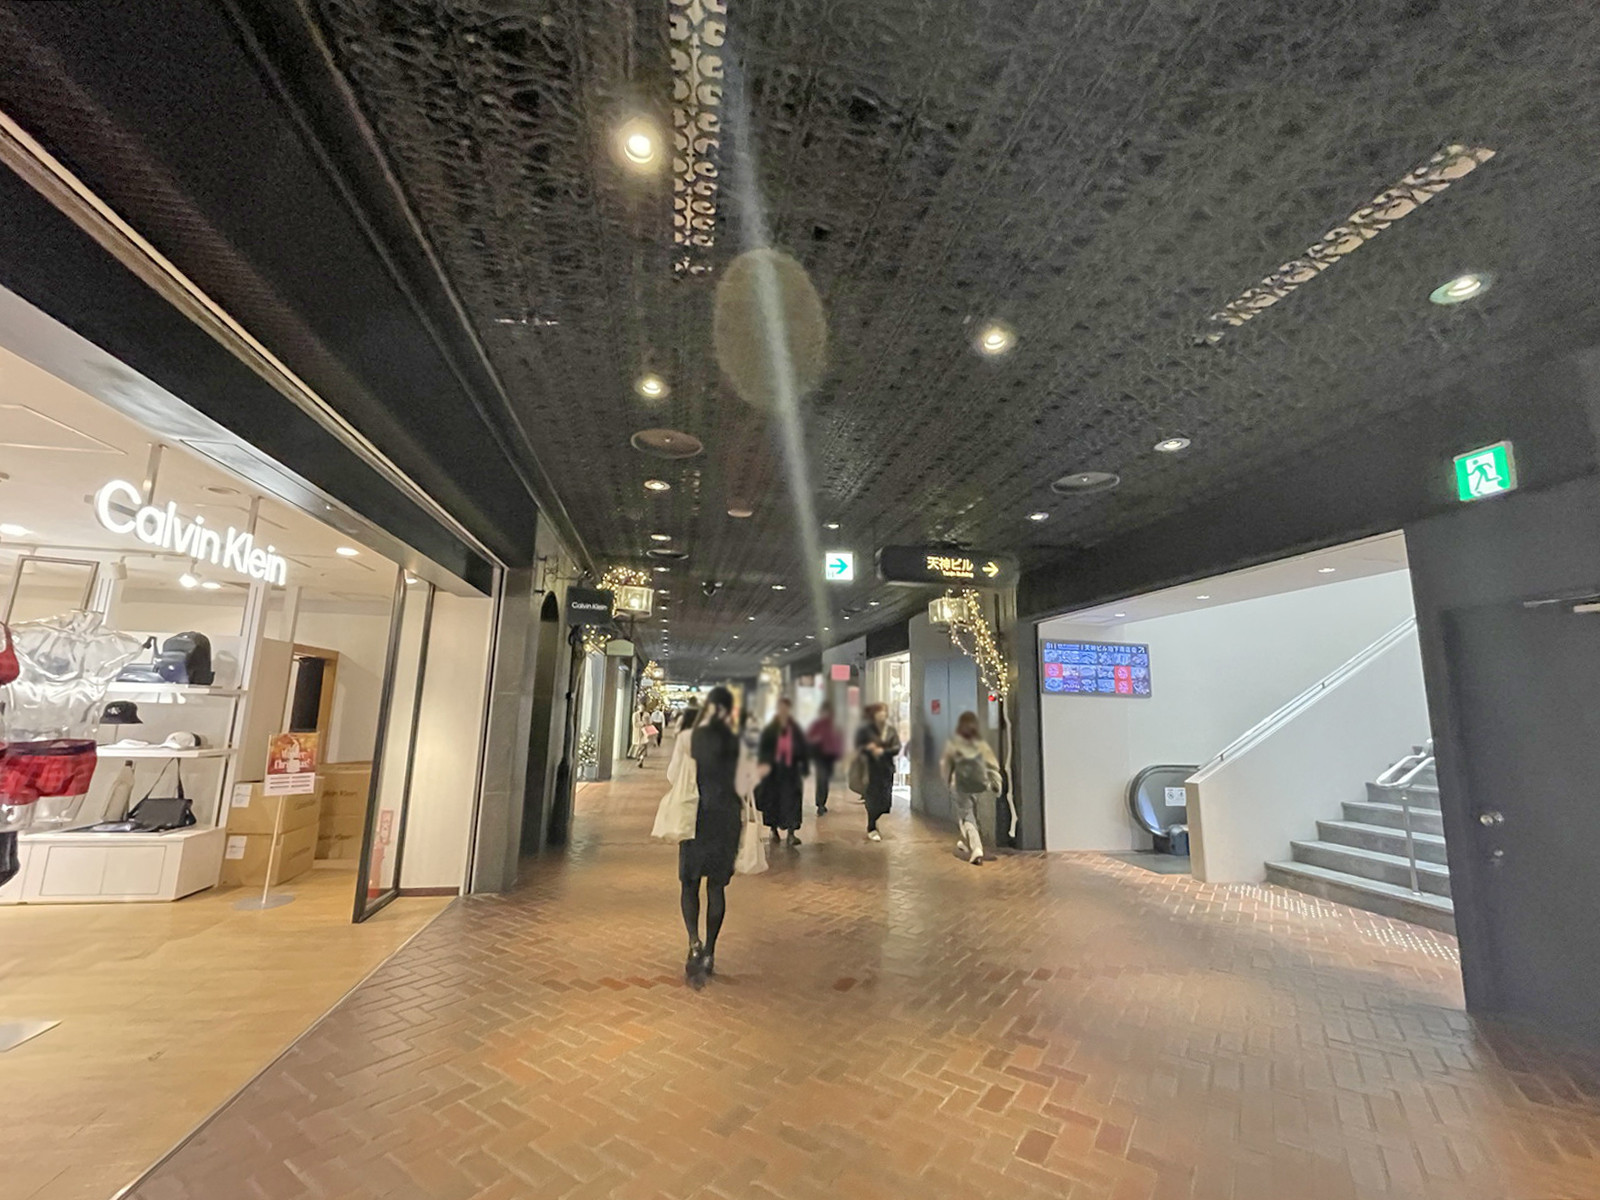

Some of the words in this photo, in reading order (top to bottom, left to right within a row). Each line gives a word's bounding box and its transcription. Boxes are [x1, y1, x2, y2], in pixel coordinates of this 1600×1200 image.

[95, 480, 220, 564] Calvin
[223, 527, 287, 586] Klein
[927, 556, 974, 571] 天神ビル
[571, 601, 592, 609] Calvin
[592, 603, 608, 611] Klein
